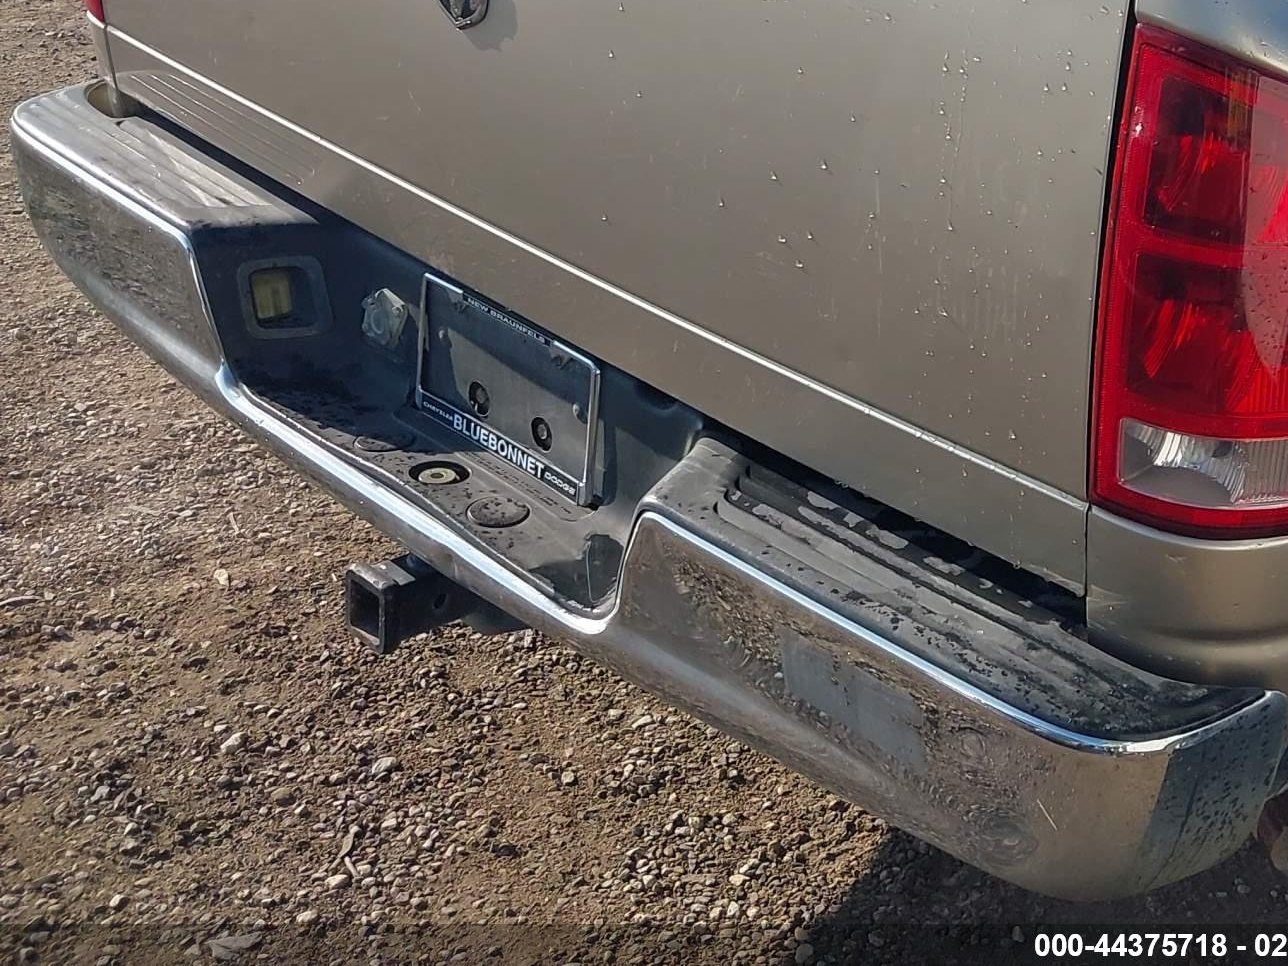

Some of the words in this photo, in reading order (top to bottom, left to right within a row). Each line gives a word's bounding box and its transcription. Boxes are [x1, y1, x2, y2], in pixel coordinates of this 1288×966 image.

[467, 297, 489, 312] NEW
[490, 309, 546, 344] BRAUNFELS
[453, 413, 545, 479] BLUEBONNET
[544, 471, 576, 496] DODGE
